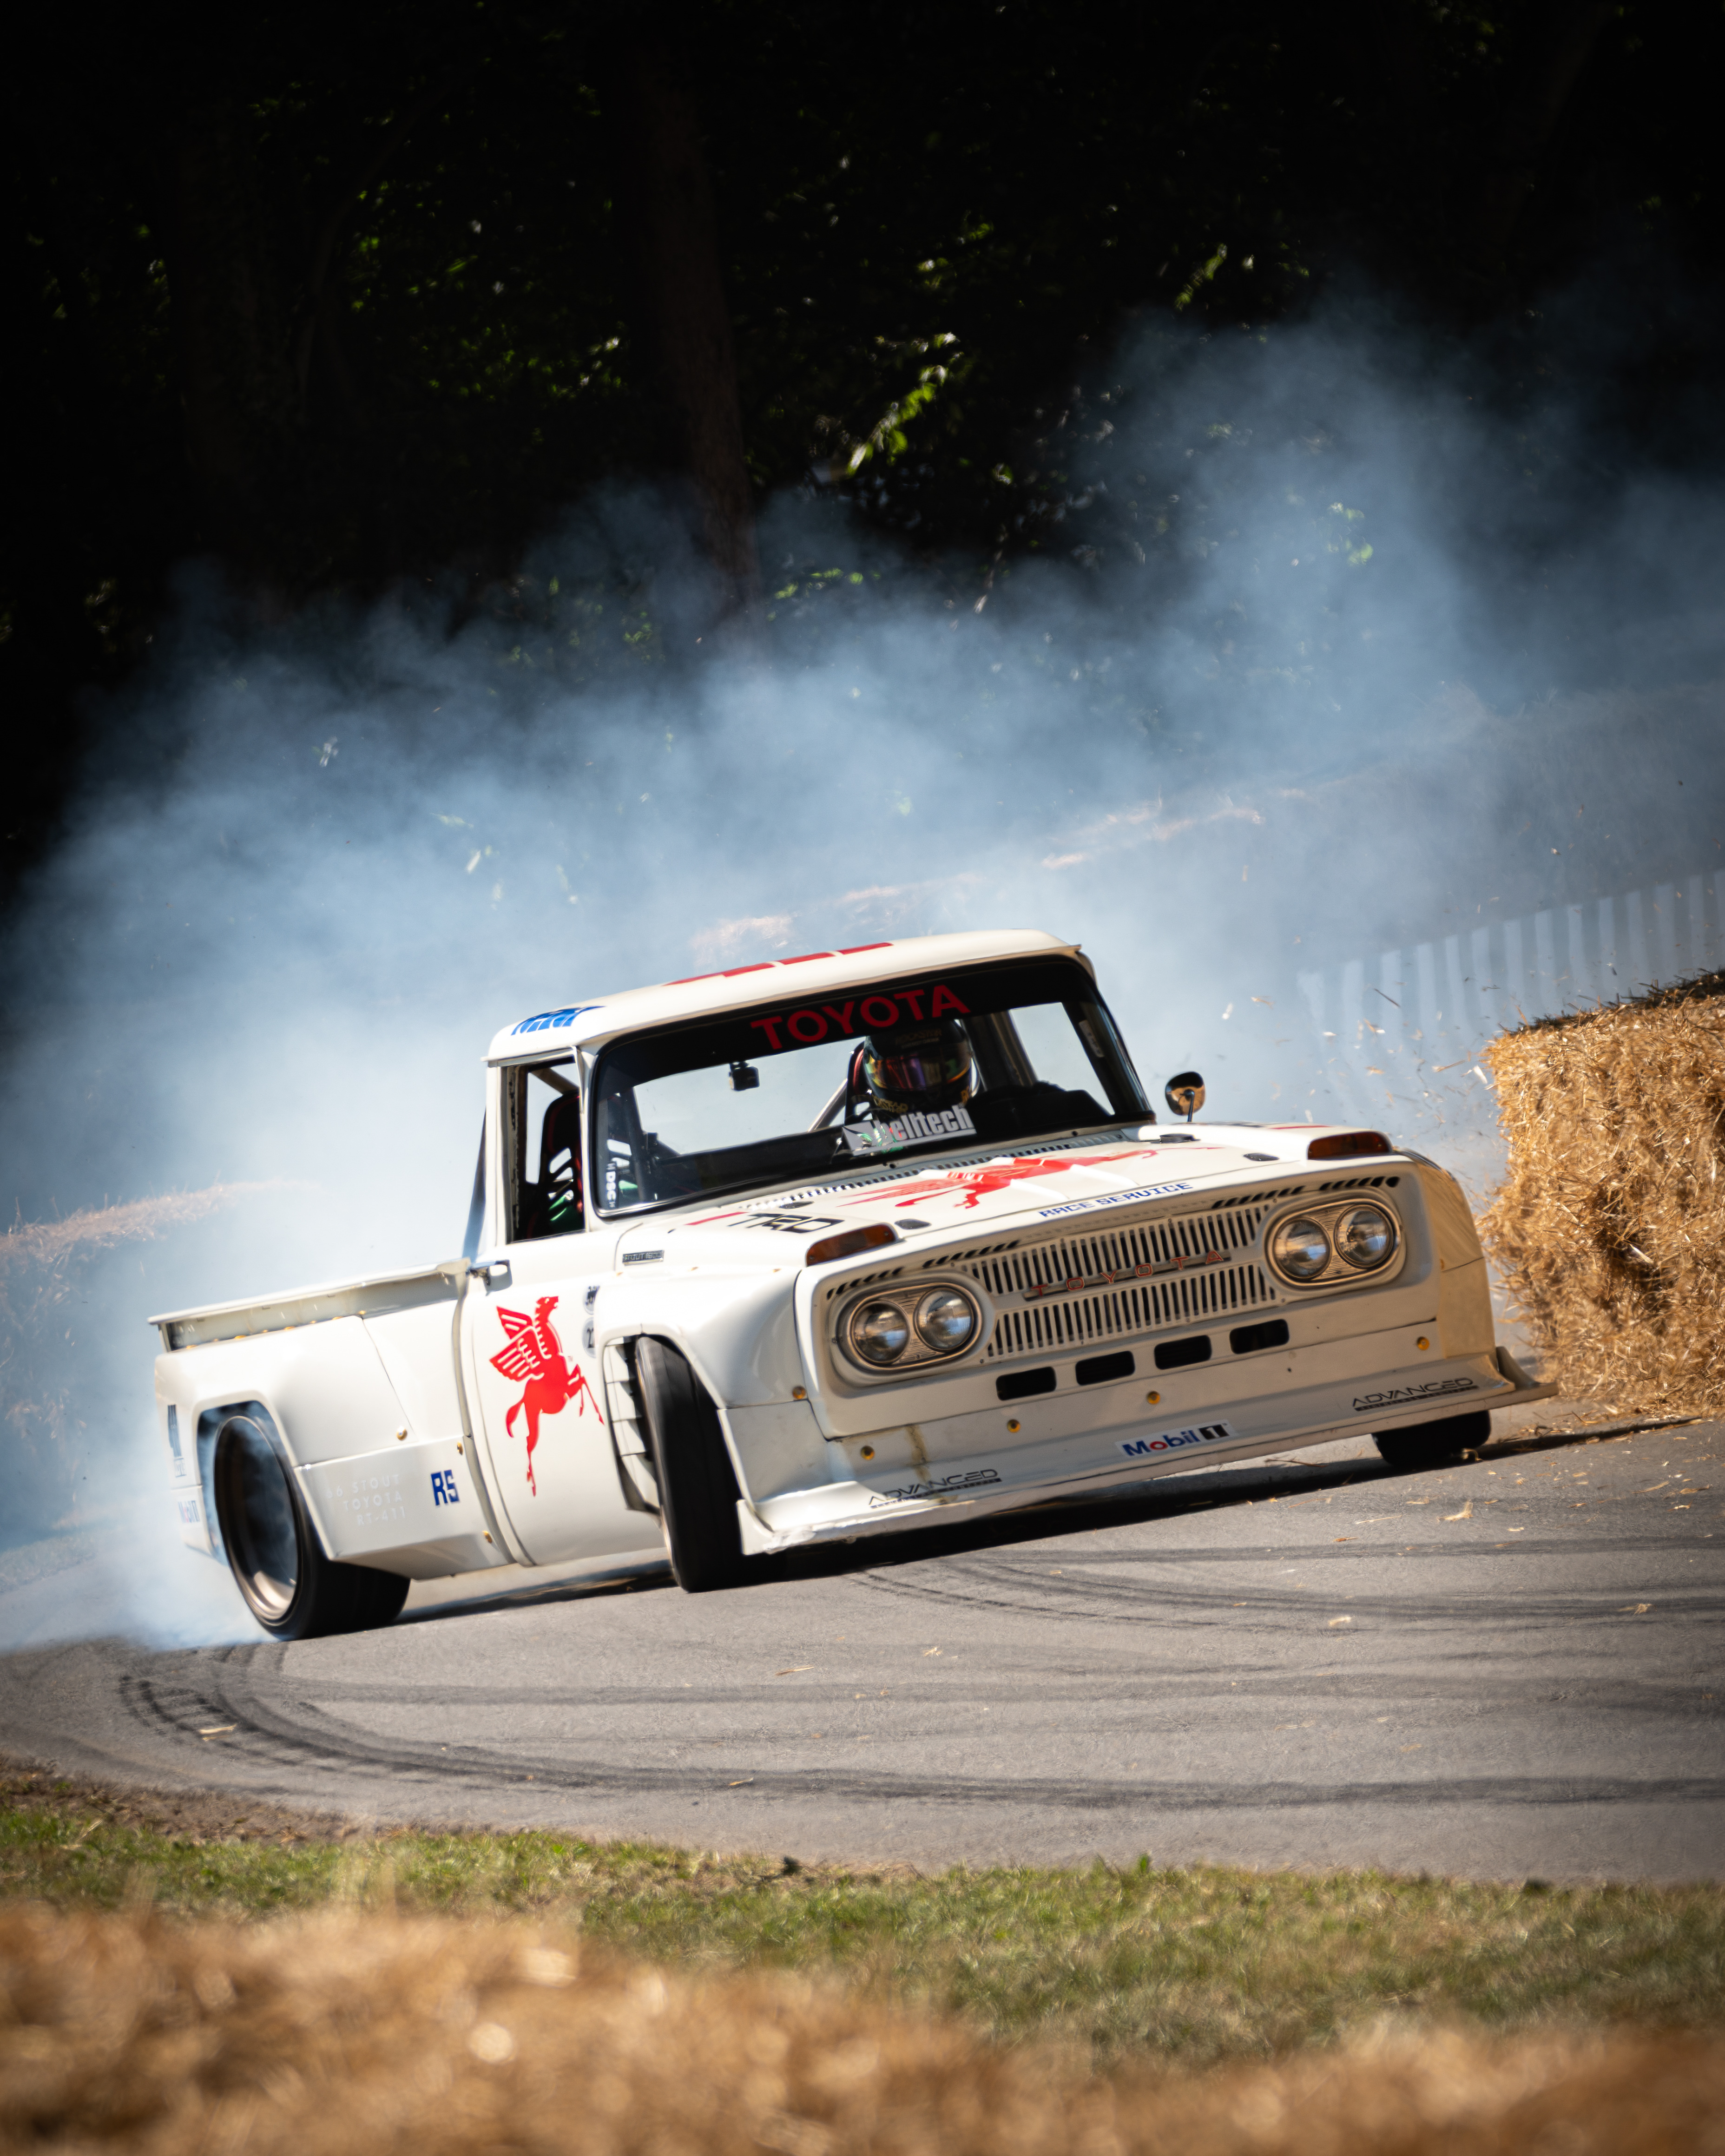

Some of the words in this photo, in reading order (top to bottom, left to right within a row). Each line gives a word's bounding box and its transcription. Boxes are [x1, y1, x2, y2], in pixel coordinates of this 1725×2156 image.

[750, 984, 971, 1050] TOYOTA
[1039, 1201, 1095, 1217] RACE
[1095, 1183, 1193, 1205] SERVICE
[1032, 1250, 1224, 1296] TOYOTA
[1352, 1377, 1474, 1407] ADVANCED
[1122, 1430, 1201, 1456] Mobil
[352, 1474, 400, 1494] STOUT
[869, 1469, 998, 1505] ADVANCED
[343, 1491, 403, 1512] TOYOTA
